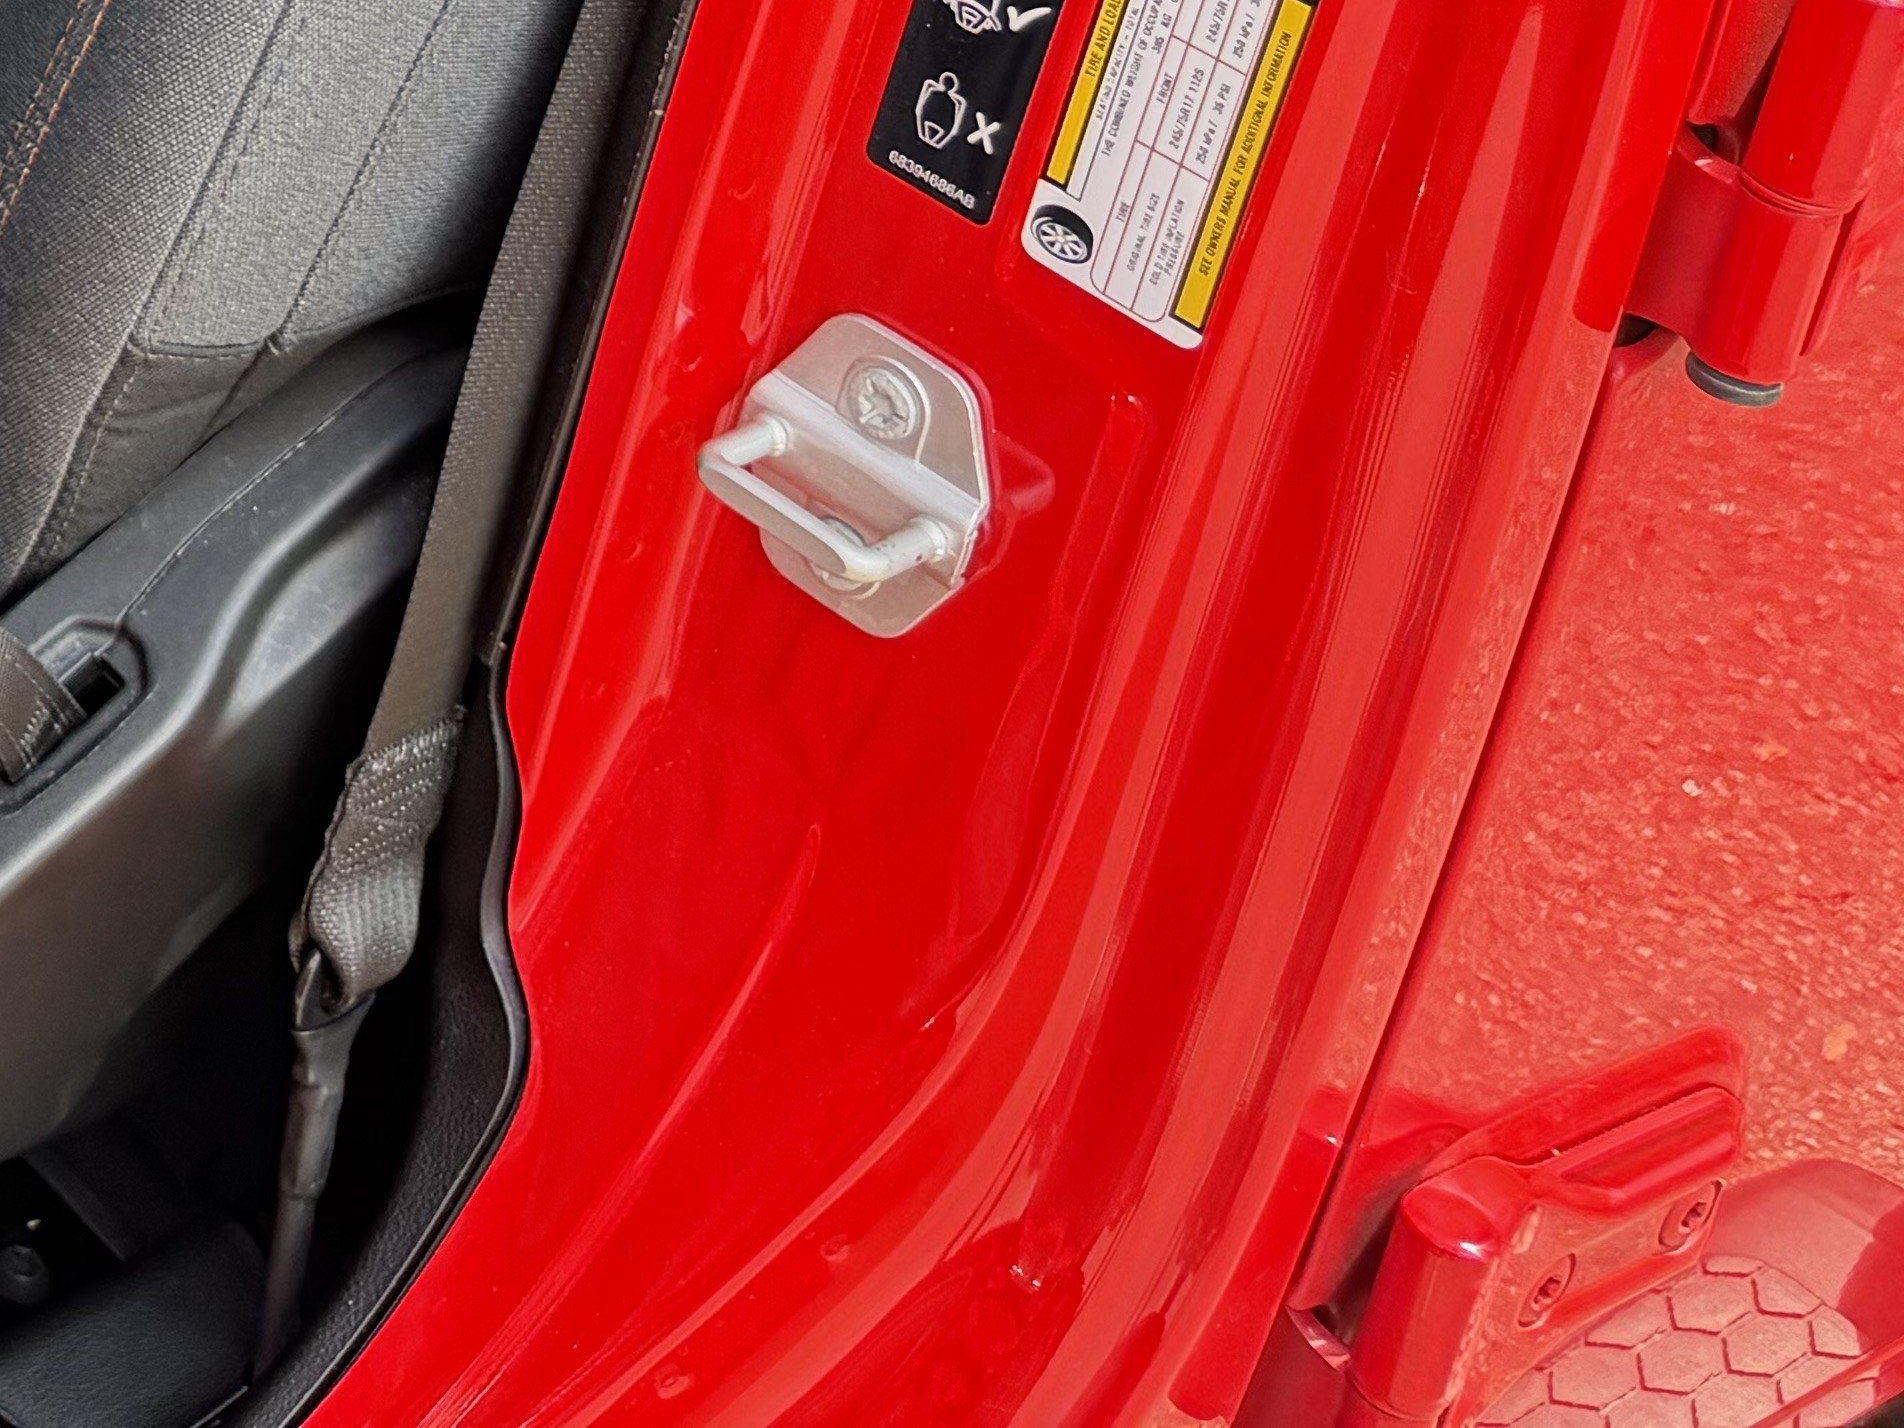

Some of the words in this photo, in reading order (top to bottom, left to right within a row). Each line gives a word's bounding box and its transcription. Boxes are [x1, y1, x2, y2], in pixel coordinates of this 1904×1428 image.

[1159, 12, 1172, 28] KG
[1084, 51, 1102, 77] TIRE
[1093, 25, 1111, 51] AND
[1260, 31, 1291, 97] INFORMATION
[1101, 138, 1115, 157] THE
[1108, 89, 1131, 137] COMBINED
[1125, 51, 1143, 87] WEIGHT
[1137, 38, 1148, 51] OF
[1156, 72, 1173, 104] FRONT
[1168, 94, 1194, 149] 245/75R17
[1187, 67, 1204, 93] 112S
[1240, 99, 1268, 154] ADDITIONAL
[1232, 153, 1248, 175] FOR
[1115, 201, 1129, 223] TIRE
[1218, 177, 1241, 217] MANUAL
[1204, 215, 1226, 257] OWNERS
[1197, 255, 1213, 276] SEE
